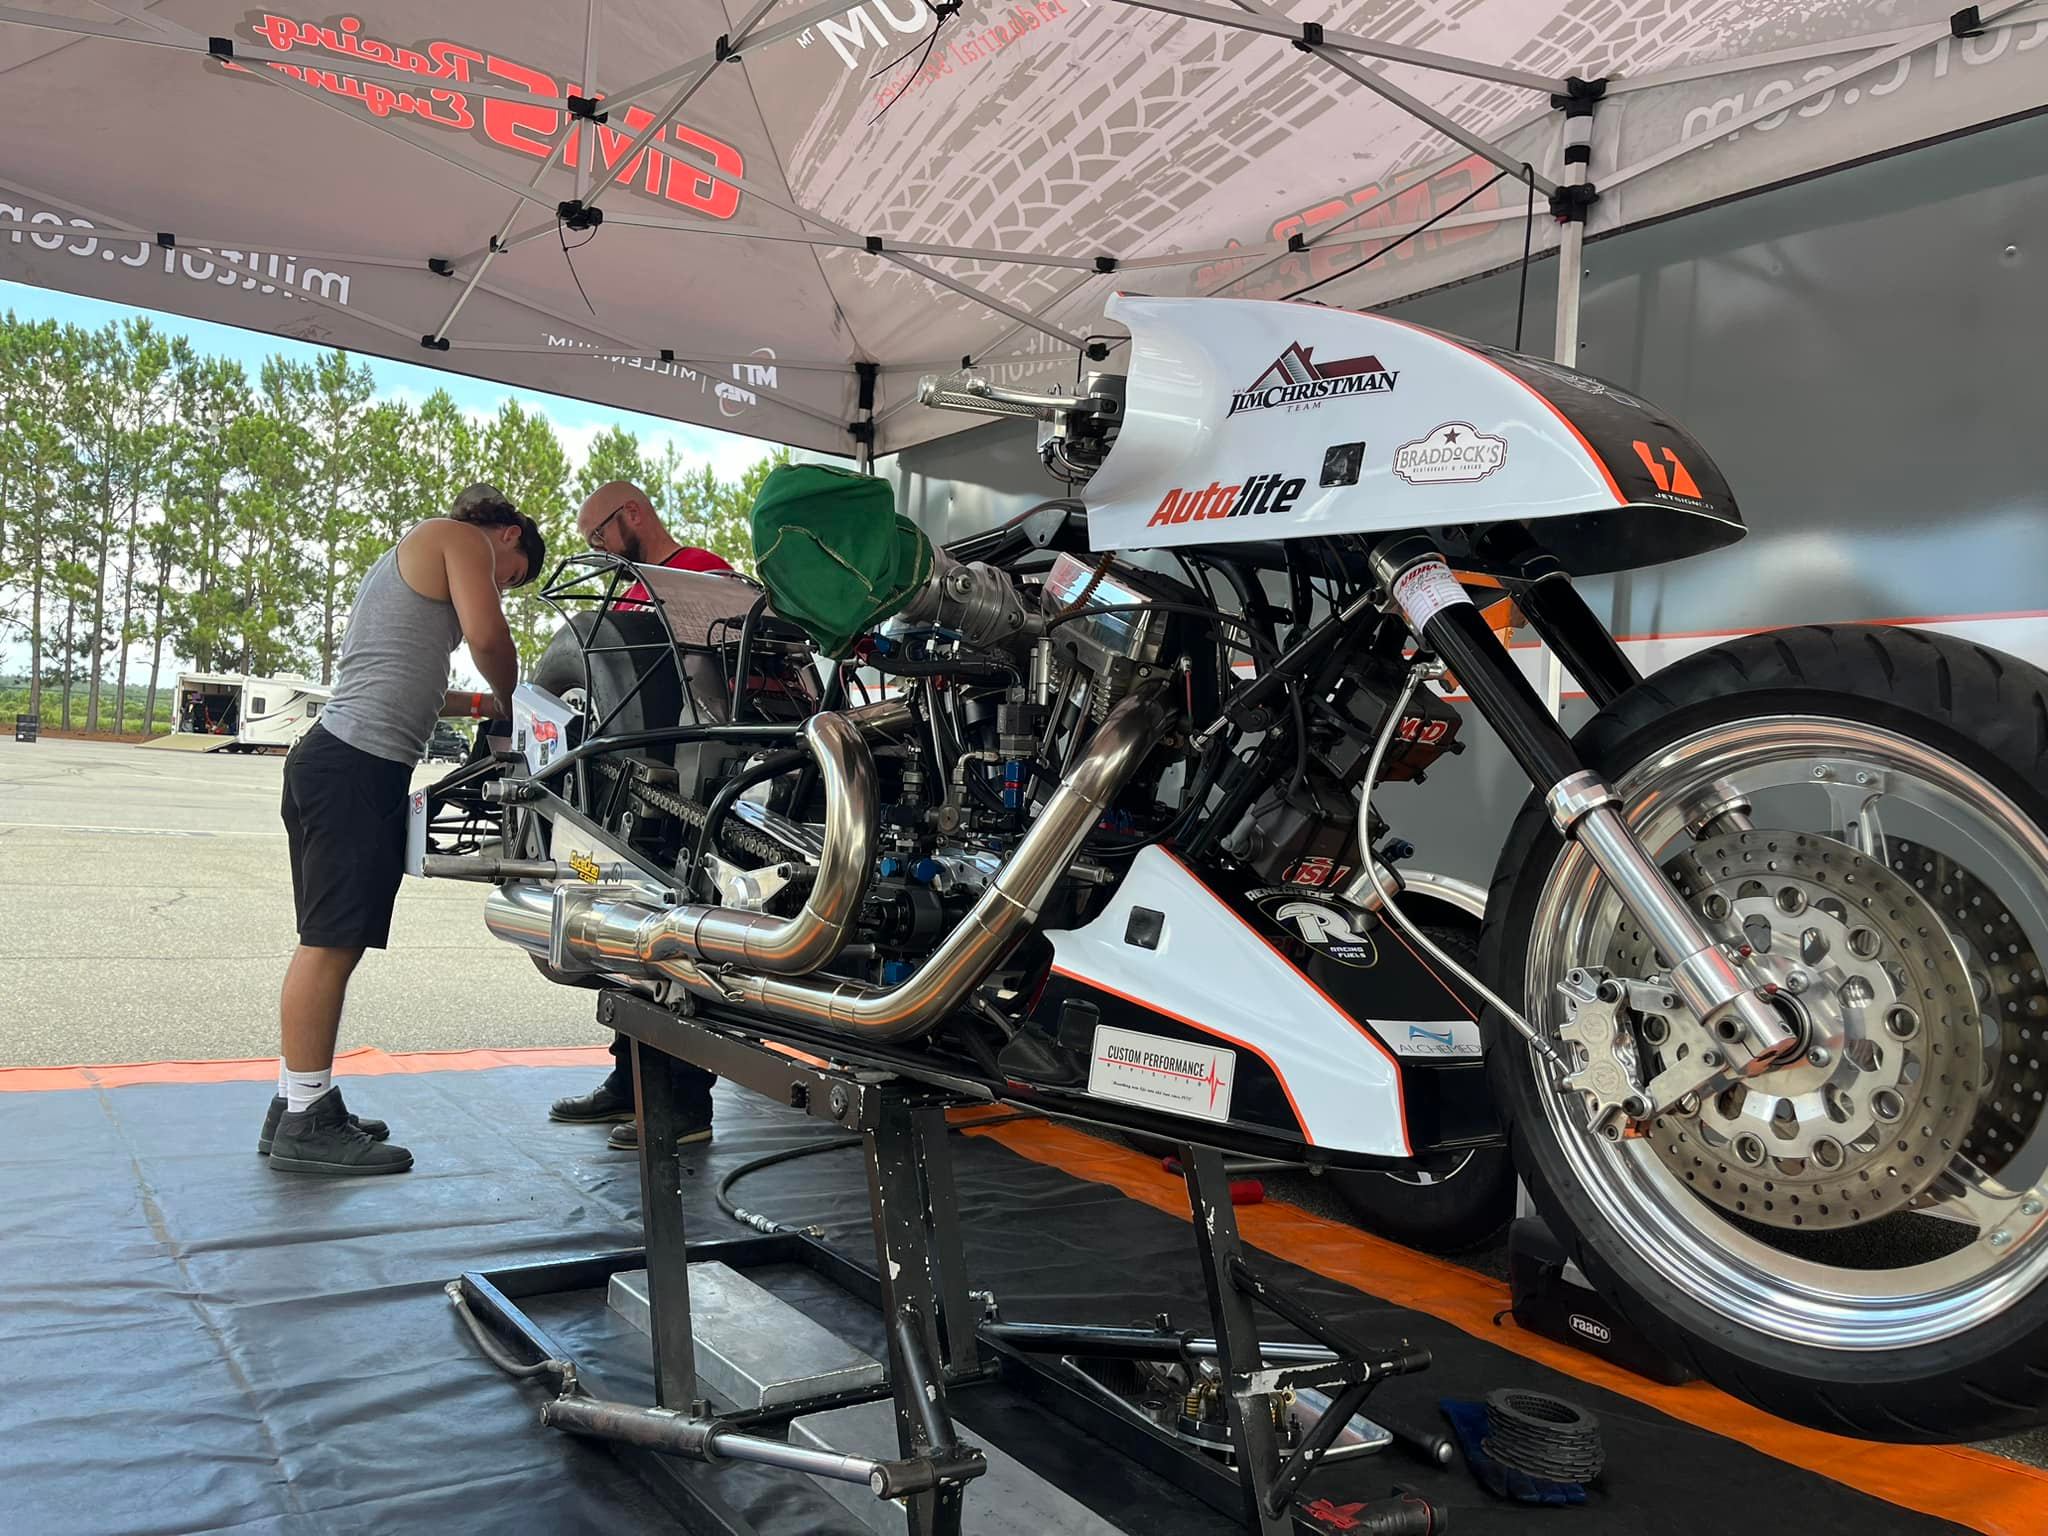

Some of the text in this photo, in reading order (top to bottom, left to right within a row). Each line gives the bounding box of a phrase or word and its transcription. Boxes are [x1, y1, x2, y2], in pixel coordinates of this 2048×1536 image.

[1287, 401, 1322, 413] TEAM
[1147, 473, 1306, 527] Autolite
[1244, 887, 1334, 901] RENEGADE
[1107, 1045, 1205, 1077] CUSTOM PERFORMANCE
[1573, 1317, 1608, 1339] raaco
